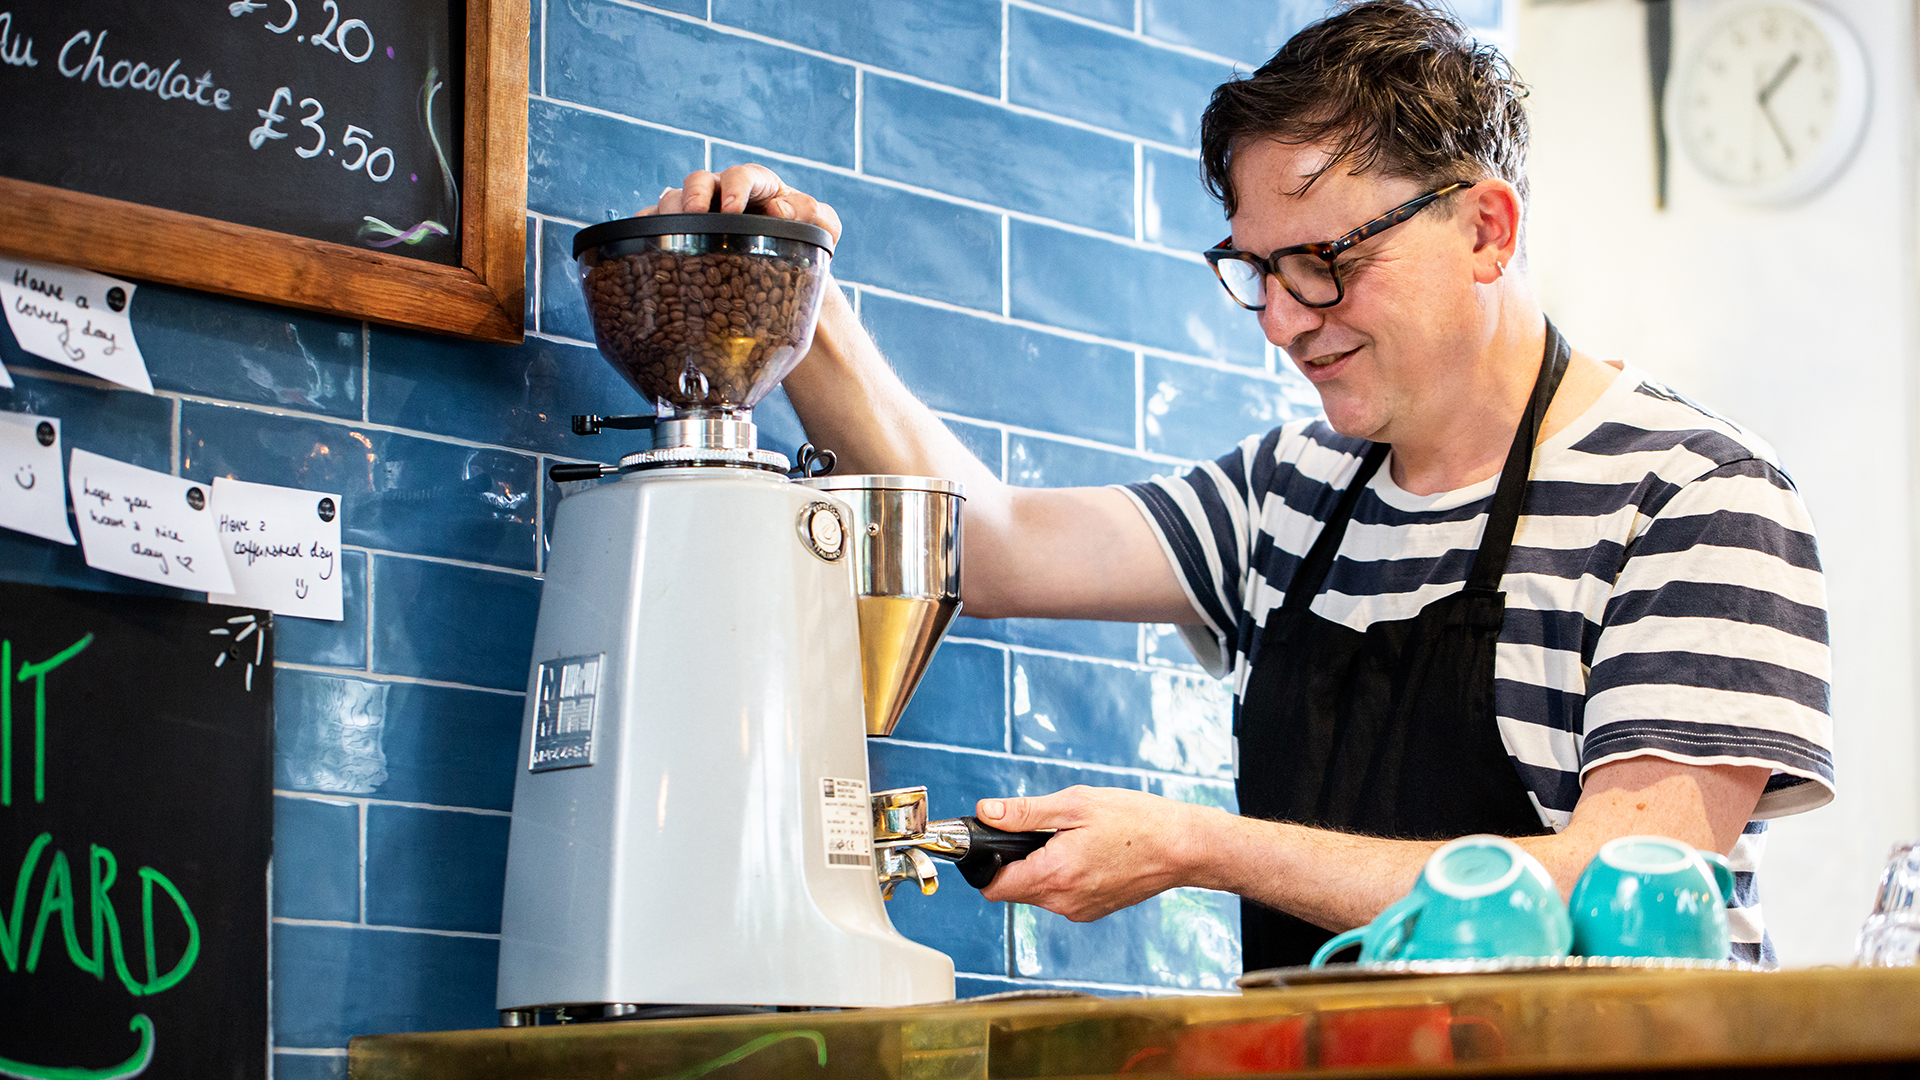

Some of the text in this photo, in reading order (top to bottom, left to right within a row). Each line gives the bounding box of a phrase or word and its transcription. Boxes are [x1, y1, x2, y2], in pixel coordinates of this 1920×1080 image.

[57, 29, 232, 111] Chocolate
[249, 86, 395, 182] £3.50
[76, 295, 89, 309] a
[82, 320, 123, 356] day
[219, 514, 250, 533] Have
[309, 541, 334, 580] day
